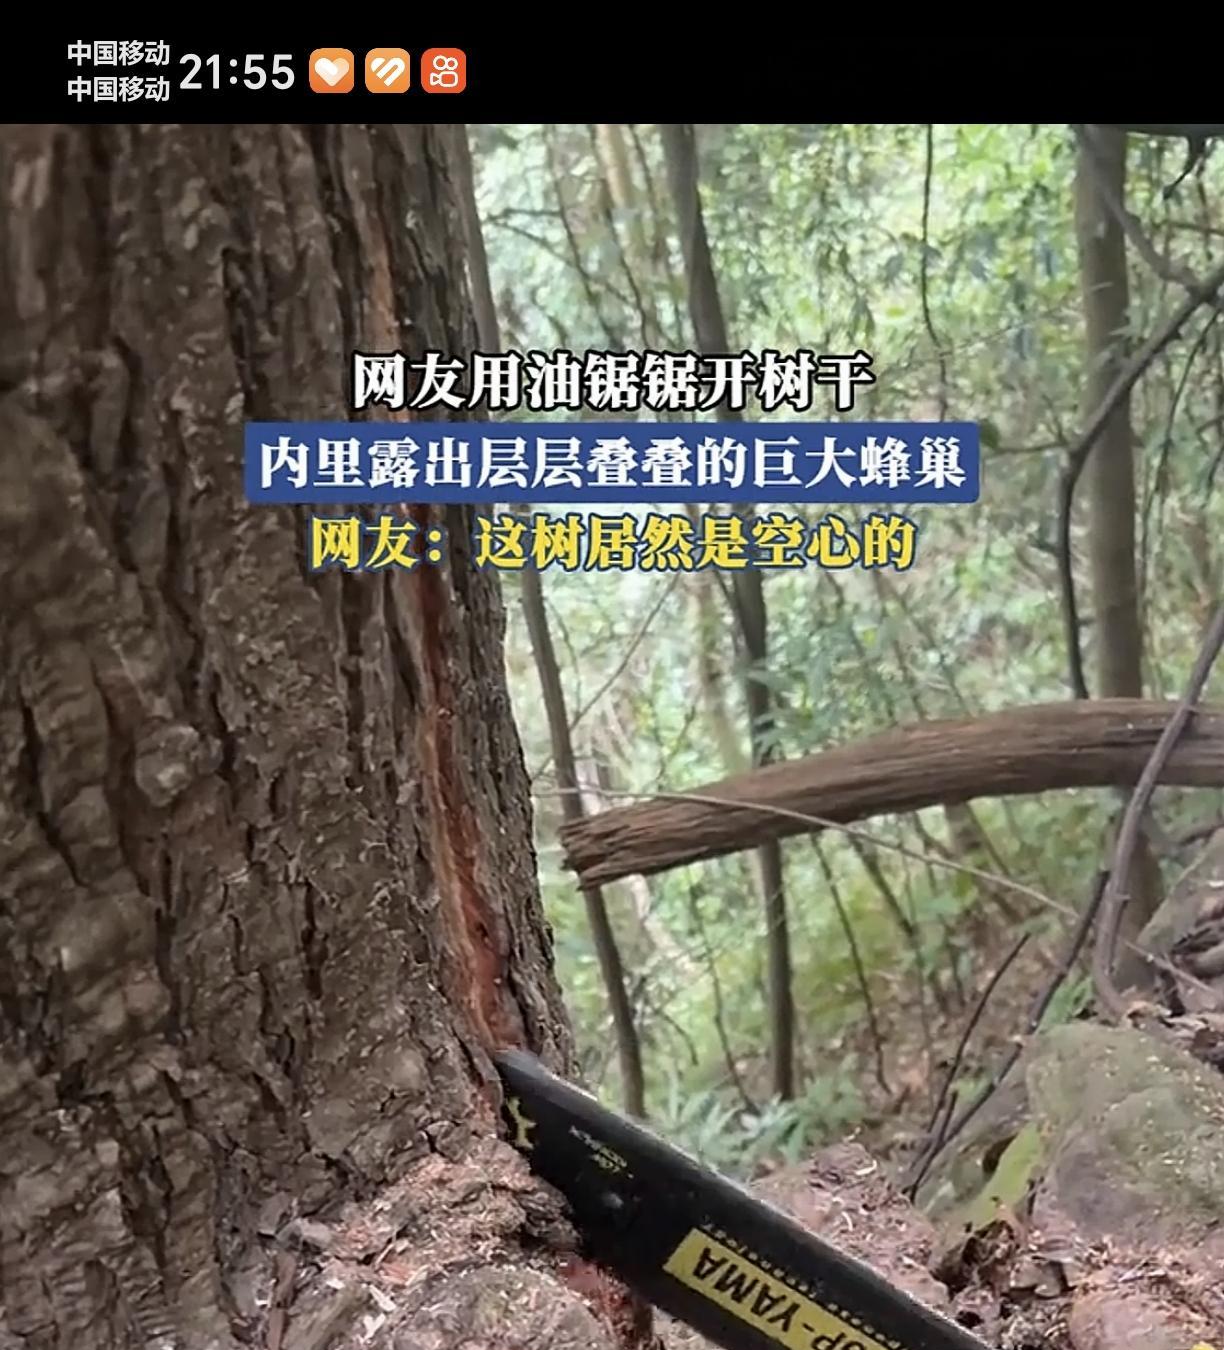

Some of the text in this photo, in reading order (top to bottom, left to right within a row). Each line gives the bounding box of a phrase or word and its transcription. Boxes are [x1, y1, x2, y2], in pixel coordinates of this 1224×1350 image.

[68, 40, 170, 67] 中国移动
[179, 53, 295, 90] 21:55
[68, 75, 170, 102] 中国移动
